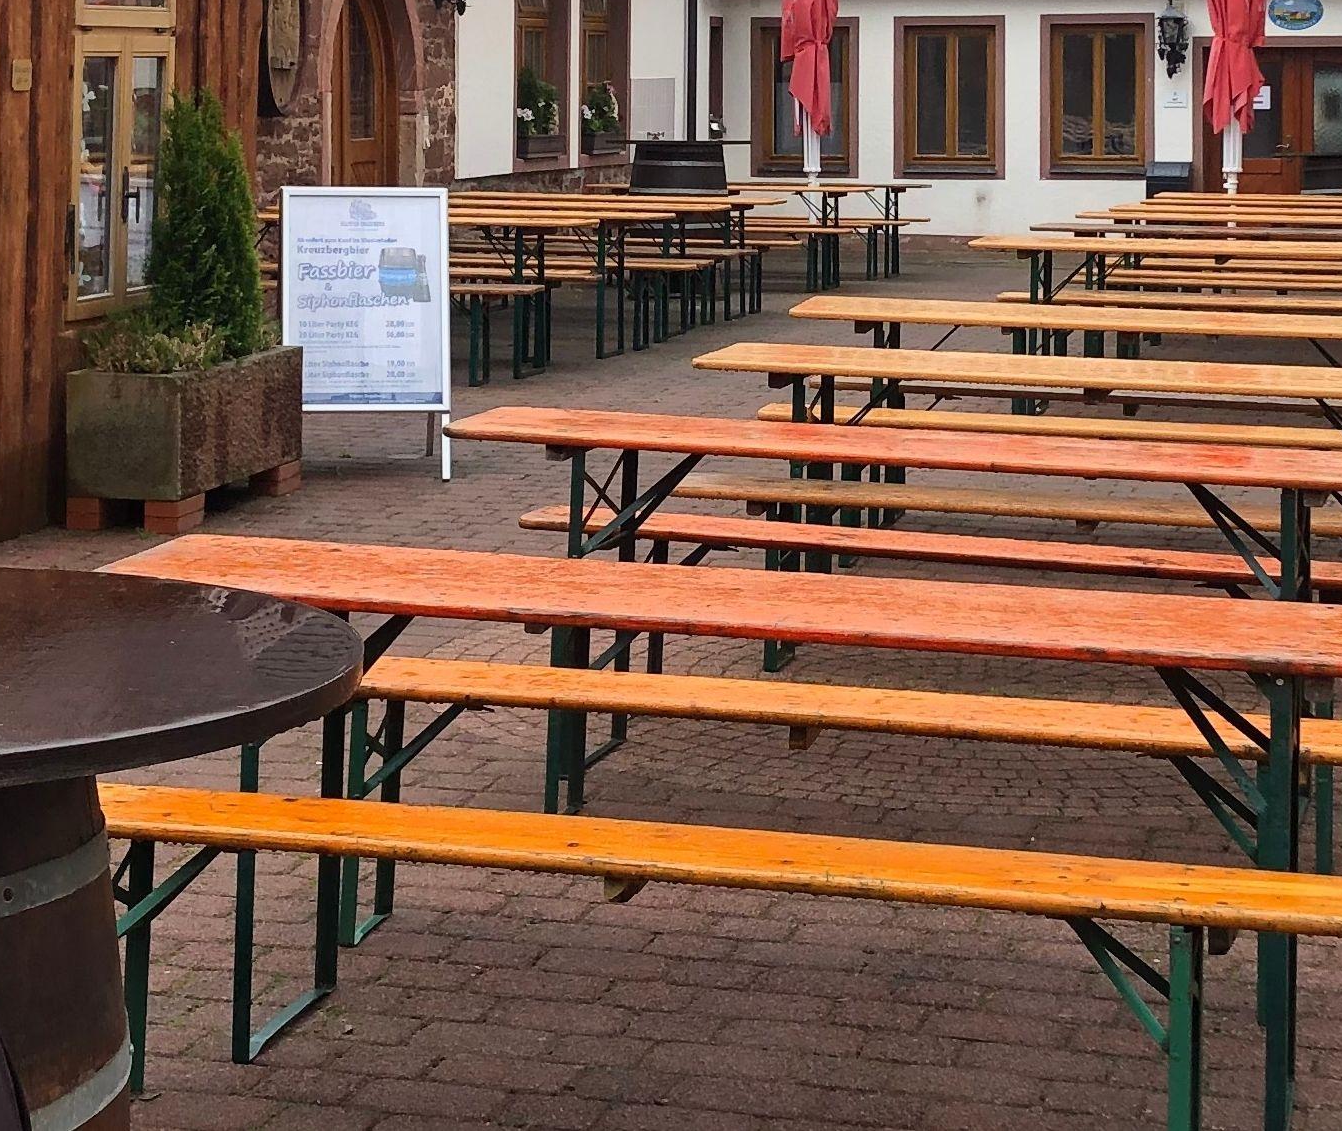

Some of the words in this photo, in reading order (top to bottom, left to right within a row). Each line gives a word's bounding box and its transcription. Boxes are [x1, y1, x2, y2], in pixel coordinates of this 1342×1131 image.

[297, 245, 370, 256] Kreuzbergbier
[298, 260, 376, 281] Fassbier
[324, 282, 333, 291] &
[297, 292, 410, 312] Siphonflaschen
[326, 321, 344, 329] Party
[326, 331, 344, 339] Party
